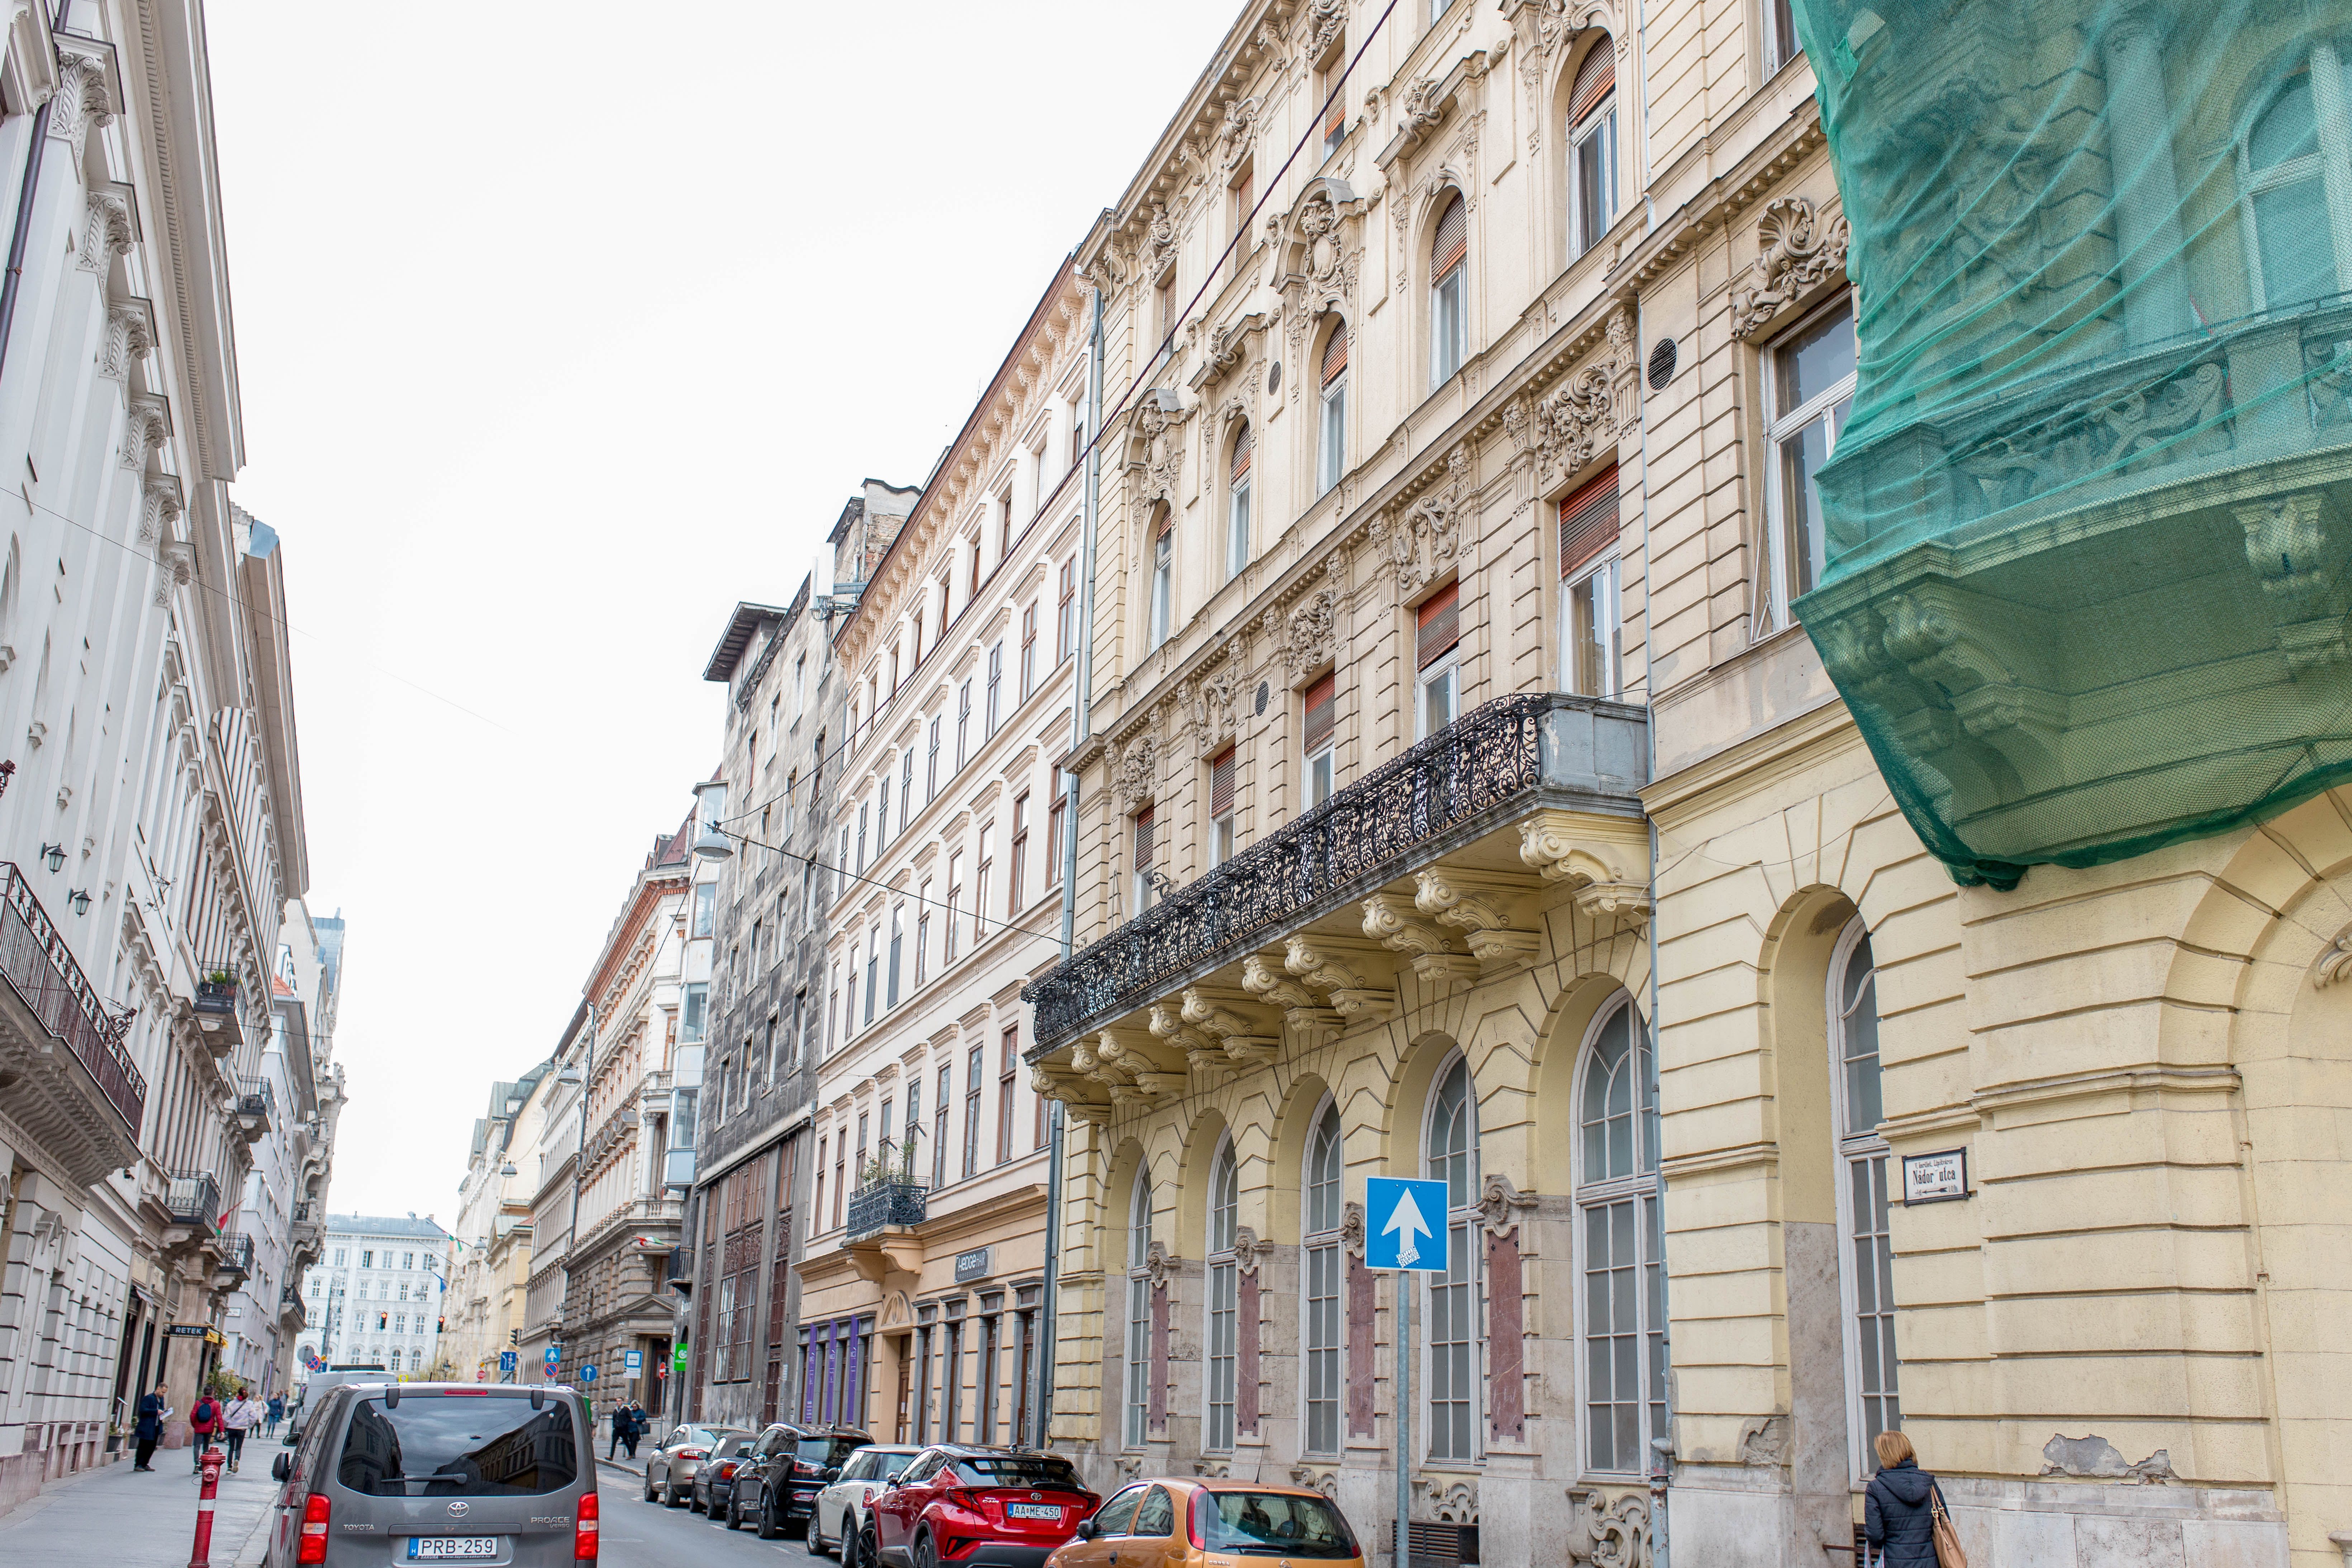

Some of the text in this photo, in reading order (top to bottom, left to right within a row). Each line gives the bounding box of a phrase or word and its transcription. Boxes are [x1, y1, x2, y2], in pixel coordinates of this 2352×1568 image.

[1913, 1166, 1956, 1185] Nádor utca
[1015, 1506, 1026, 1515] AA
[422, 1539, 493, 1554] PRB-259
